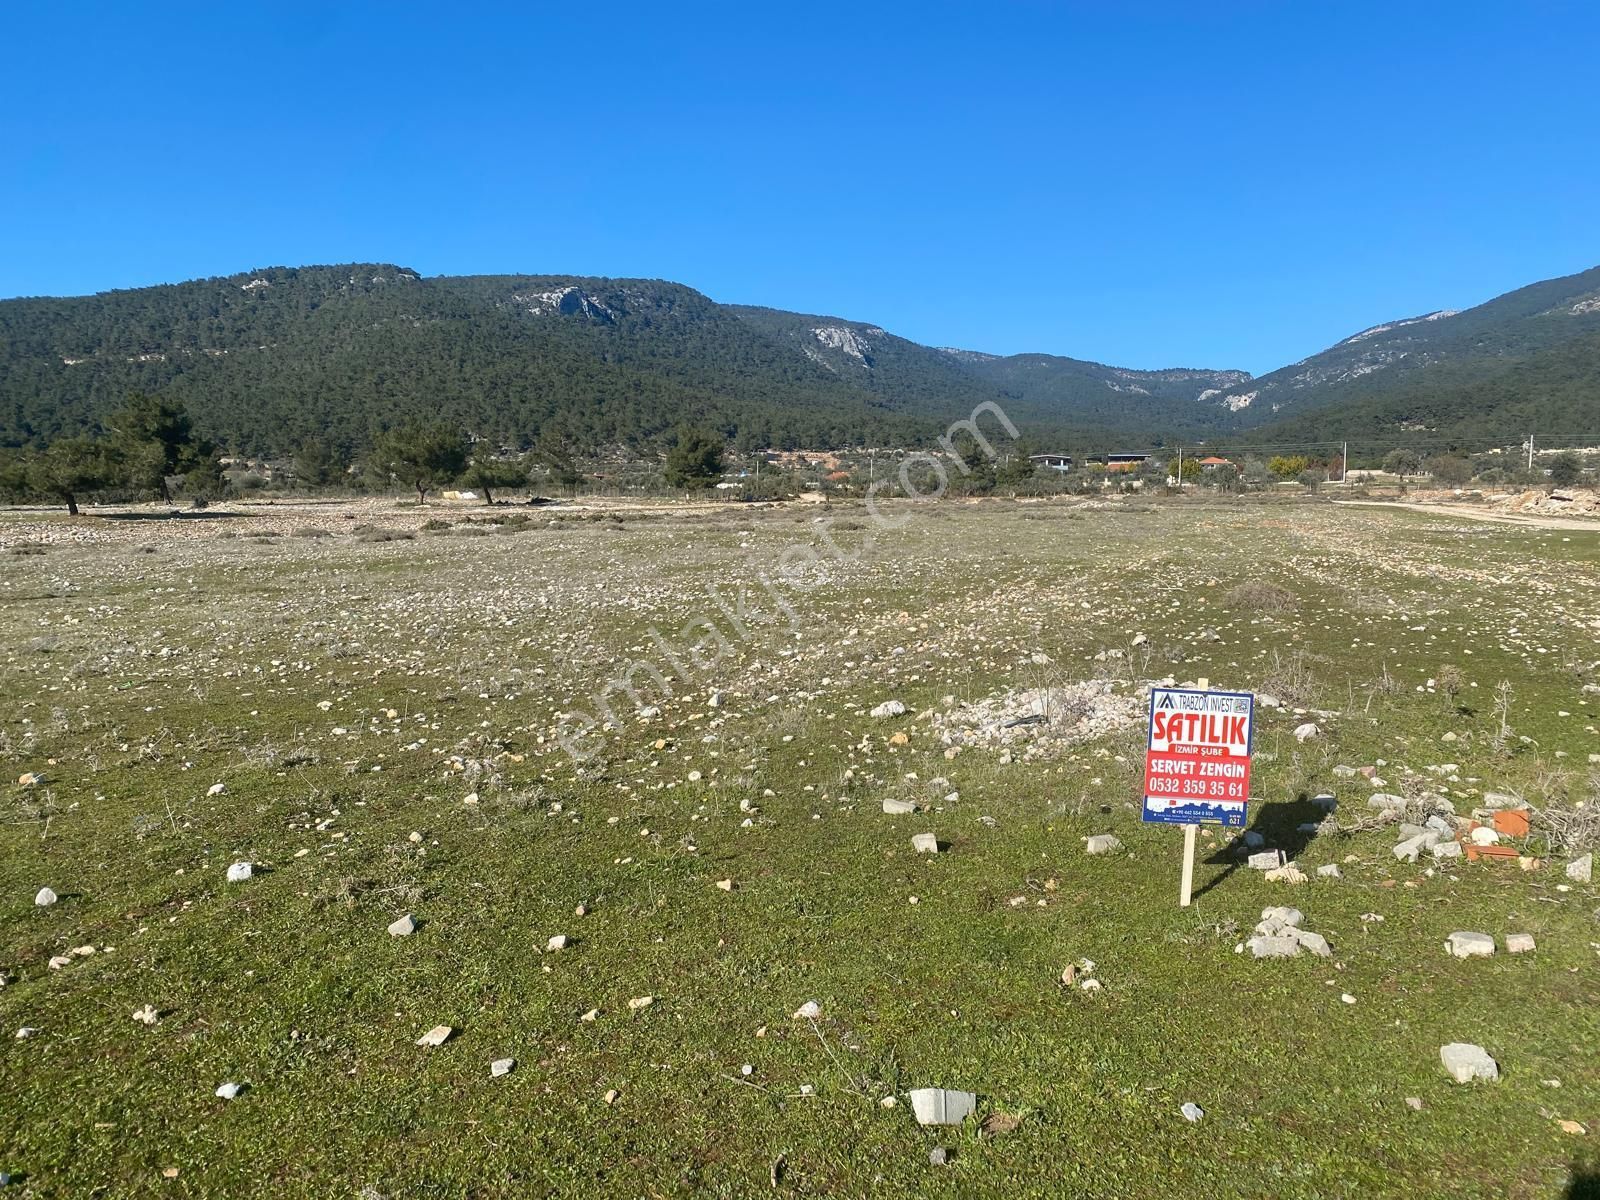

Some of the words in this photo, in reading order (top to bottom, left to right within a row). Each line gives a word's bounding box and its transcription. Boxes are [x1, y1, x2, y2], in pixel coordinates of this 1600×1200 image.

[1179, 694, 1210, 711] TRABZON
[1210, 696, 1233, 713] INVEST
[1153, 711, 1247, 746] SATILIK
[1174, 744, 1199, 755] İZMİR
[1201, 747, 1223, 757] ŞUBE
[1151, 759, 1196, 775] SERVET
[1199, 761, 1245, 778] ZENGİN
[1149, 776, 1179, 793] 0532
[1183, 779, 1206, 794] 359
[1209, 781, 1225, 796] 35
[1229, 782, 1243, 797] 61
